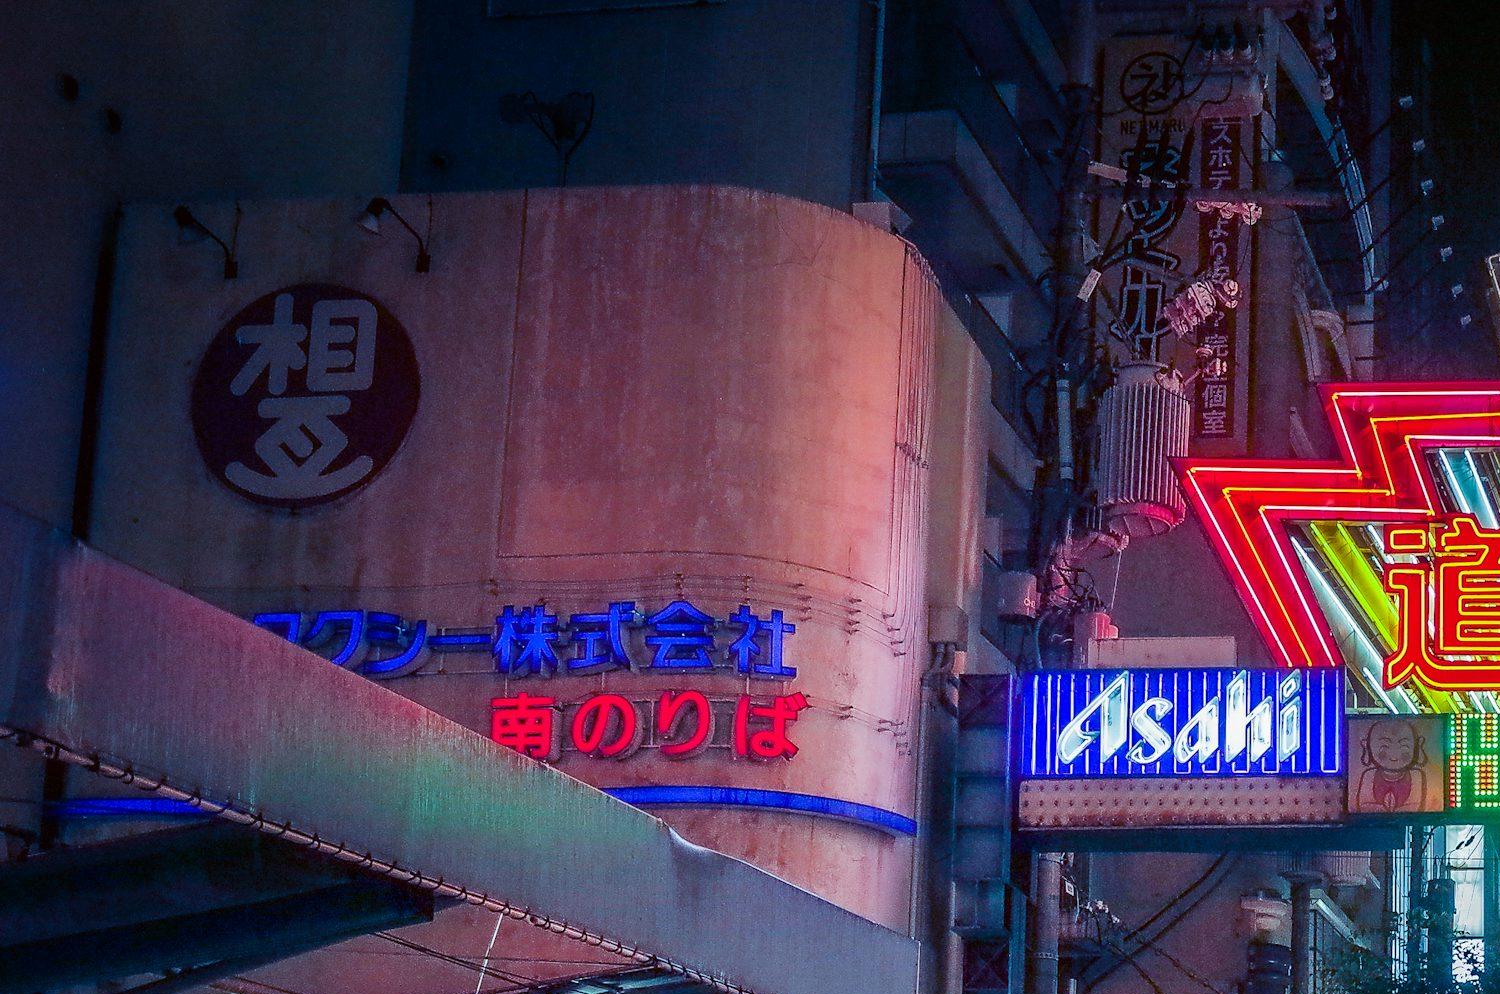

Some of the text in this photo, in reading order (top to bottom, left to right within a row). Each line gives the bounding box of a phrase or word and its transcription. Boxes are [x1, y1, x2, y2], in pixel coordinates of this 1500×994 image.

[490, 690, 807, 761] 南のりば
[1056, 669, 1303, 765] Asahi
